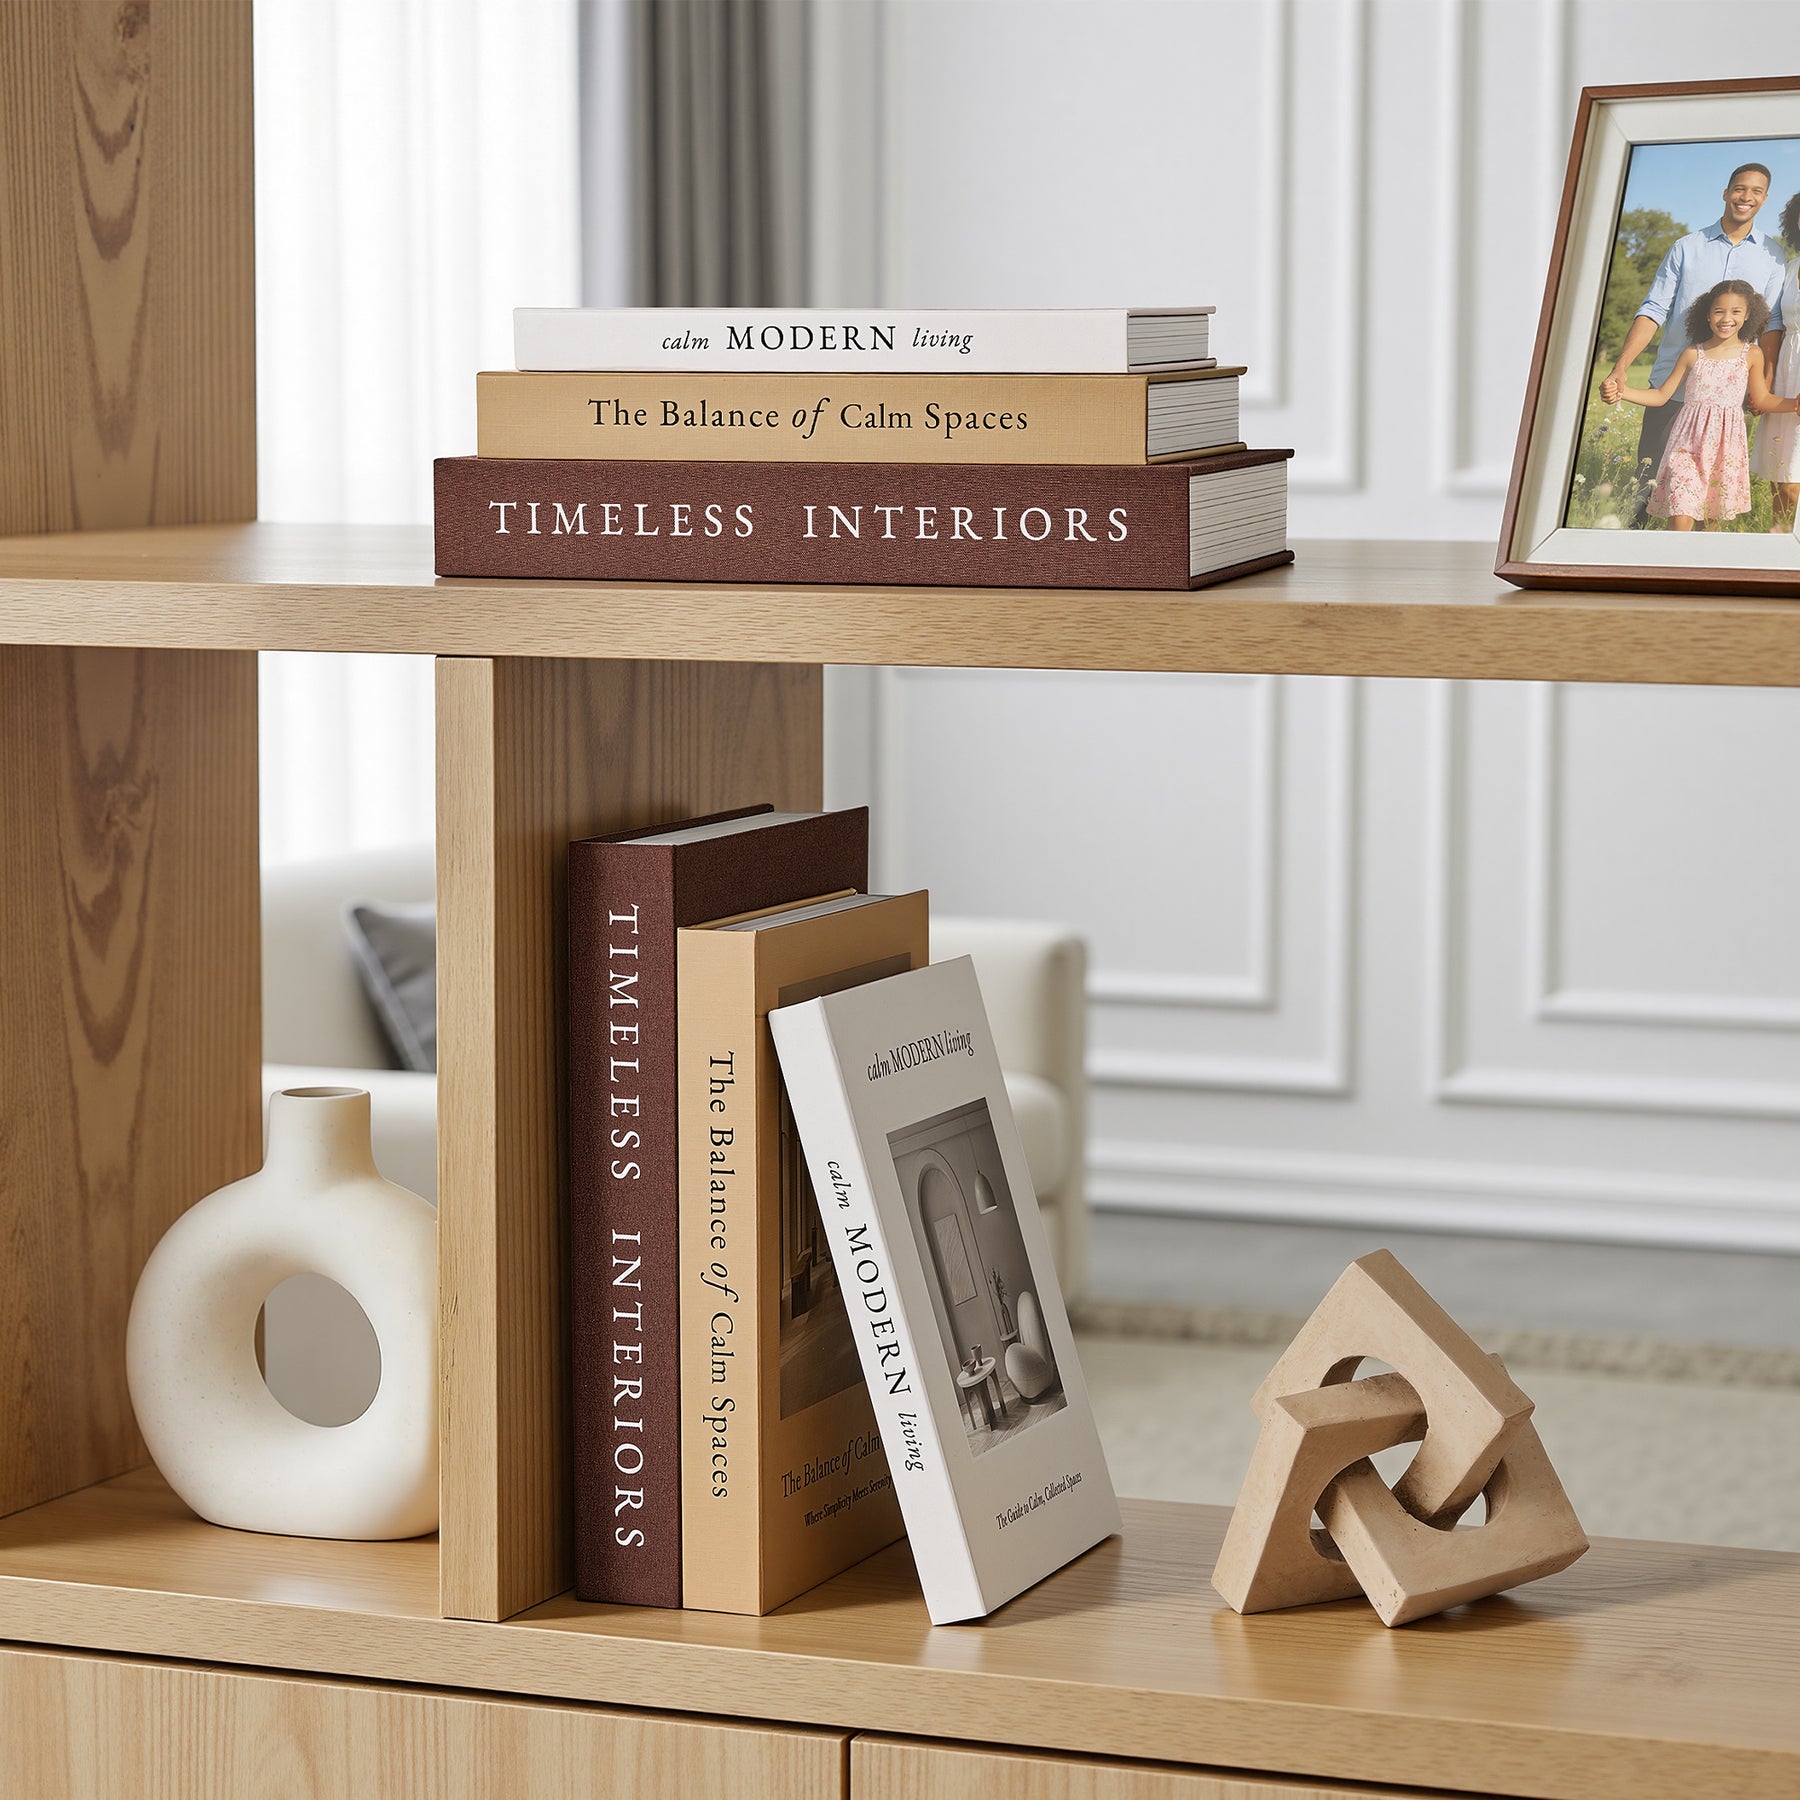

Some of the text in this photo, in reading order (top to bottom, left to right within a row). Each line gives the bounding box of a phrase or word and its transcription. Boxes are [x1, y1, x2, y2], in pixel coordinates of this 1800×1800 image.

[662, 325, 974, 355] calm MODERN living
[587, 397, 1028, 440] The Balance of Calm Spaces
[488, 500, 1128, 542] TIMELESS INTERIORS
[867, 1029, 975, 1082] calm MODERN living
[608, 903, 645, 1548] TIMELESS INTERIORS
[700, 1050, 739, 1499] The Balance of Calm Spaces
[827, 1160, 925, 1472] calm MODERN living
[781, 1431, 880, 1498] The Balance of Calm
[803, 1510, 823, 1527] Where
[823, 1494, 852, 1518] Simplicity
[851, 1486, 869, 1503] Meets
[995, 1512, 1008, 1530] The
[1006, 1502, 1024, 1523] Guide
[1044, 1475, 1067, 1501] Collected
[1065, 1472, 1083, 1493] Spaces
